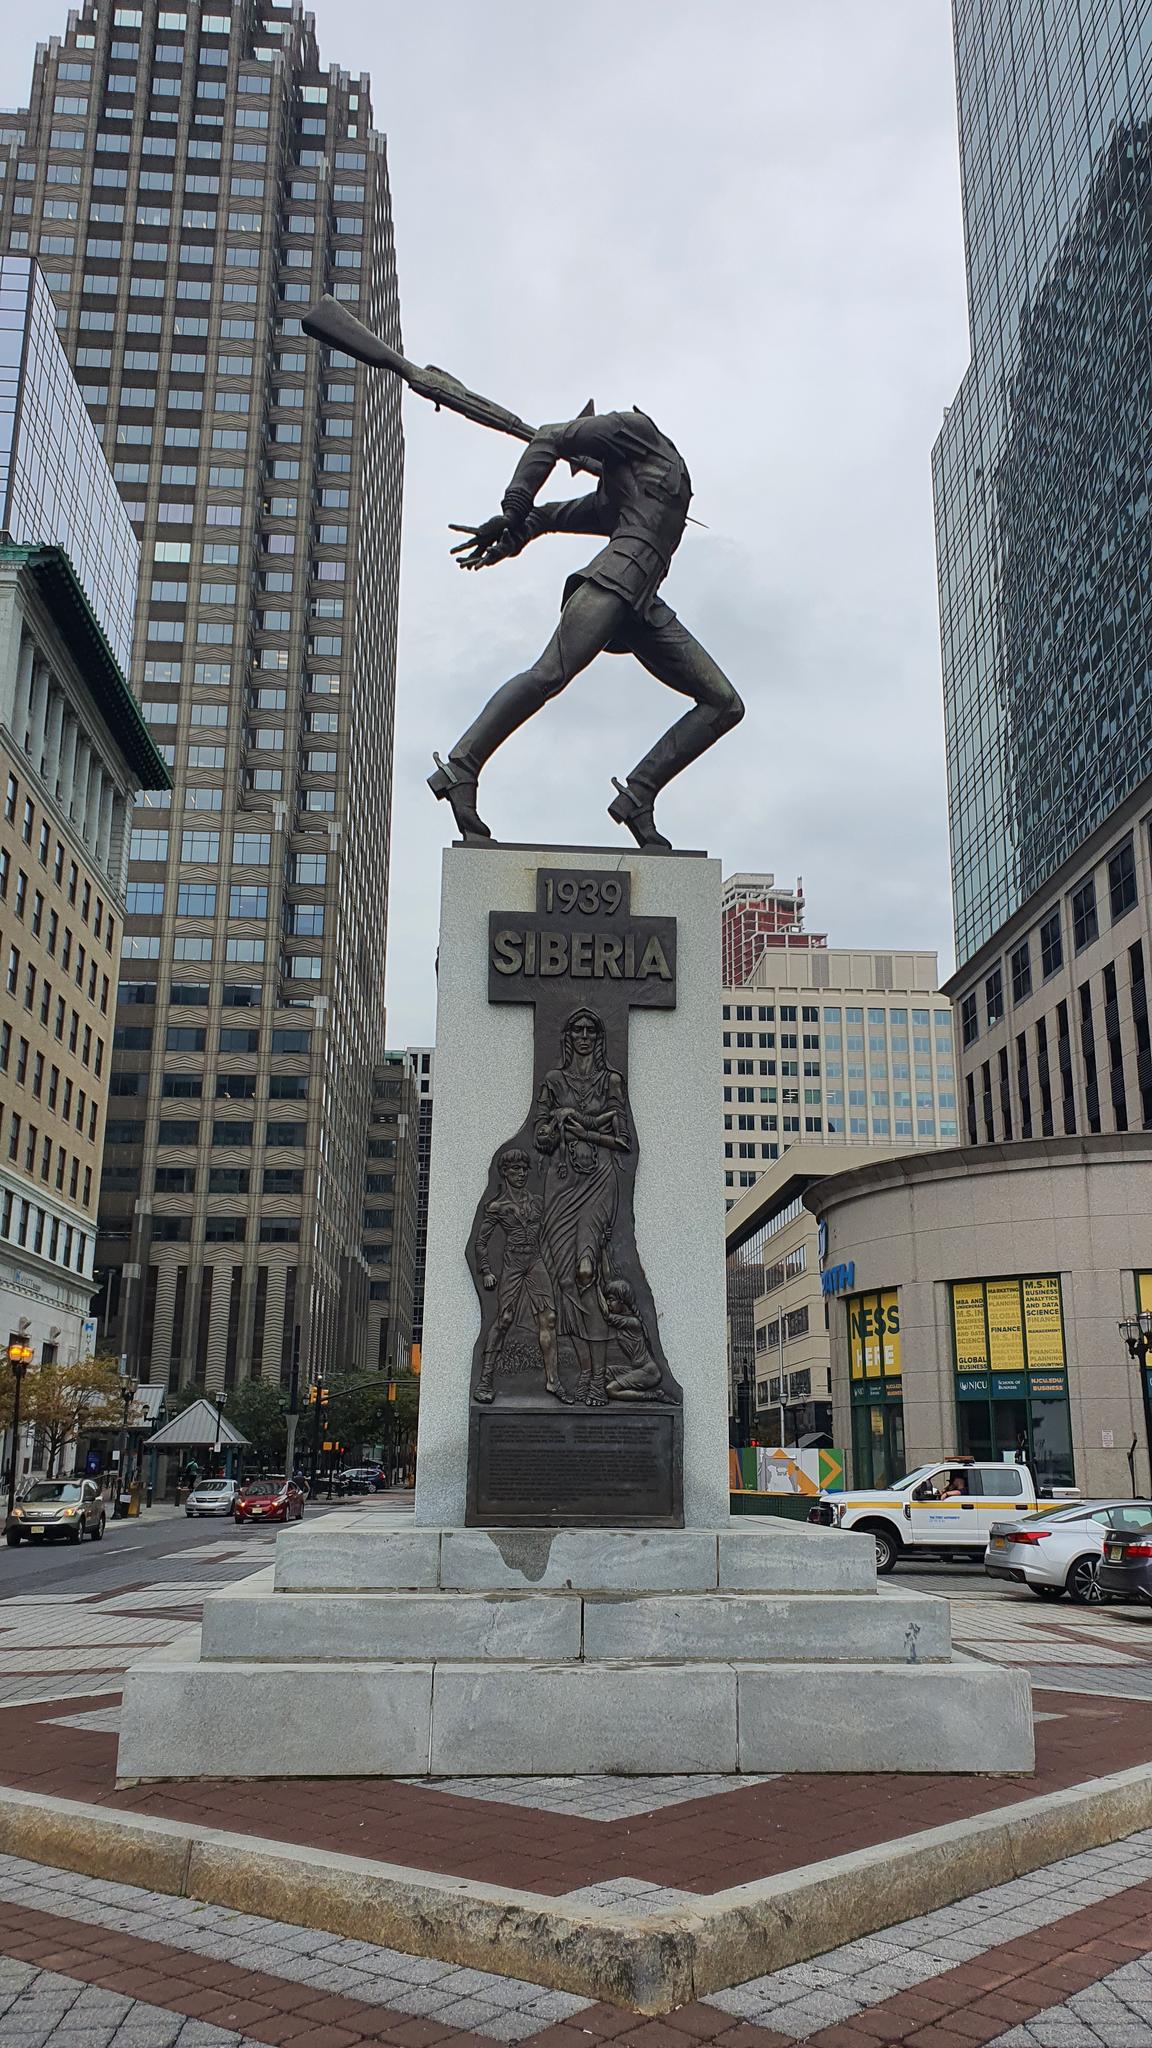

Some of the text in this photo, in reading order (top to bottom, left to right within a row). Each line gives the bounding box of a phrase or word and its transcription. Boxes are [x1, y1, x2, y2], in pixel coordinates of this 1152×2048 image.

[545, 879, 622, 914] 1939
[492, 930, 673, 980] SIBERIA
[1025, 1281, 1045, 1289] M.S.
[1046, 1280, 1057, 1288] IN
[856, 1344, 894, 1368] HERE
[959, 1356, 986, 1364] GLOBAL
[969, 1381, 988, 1390] NJCU
